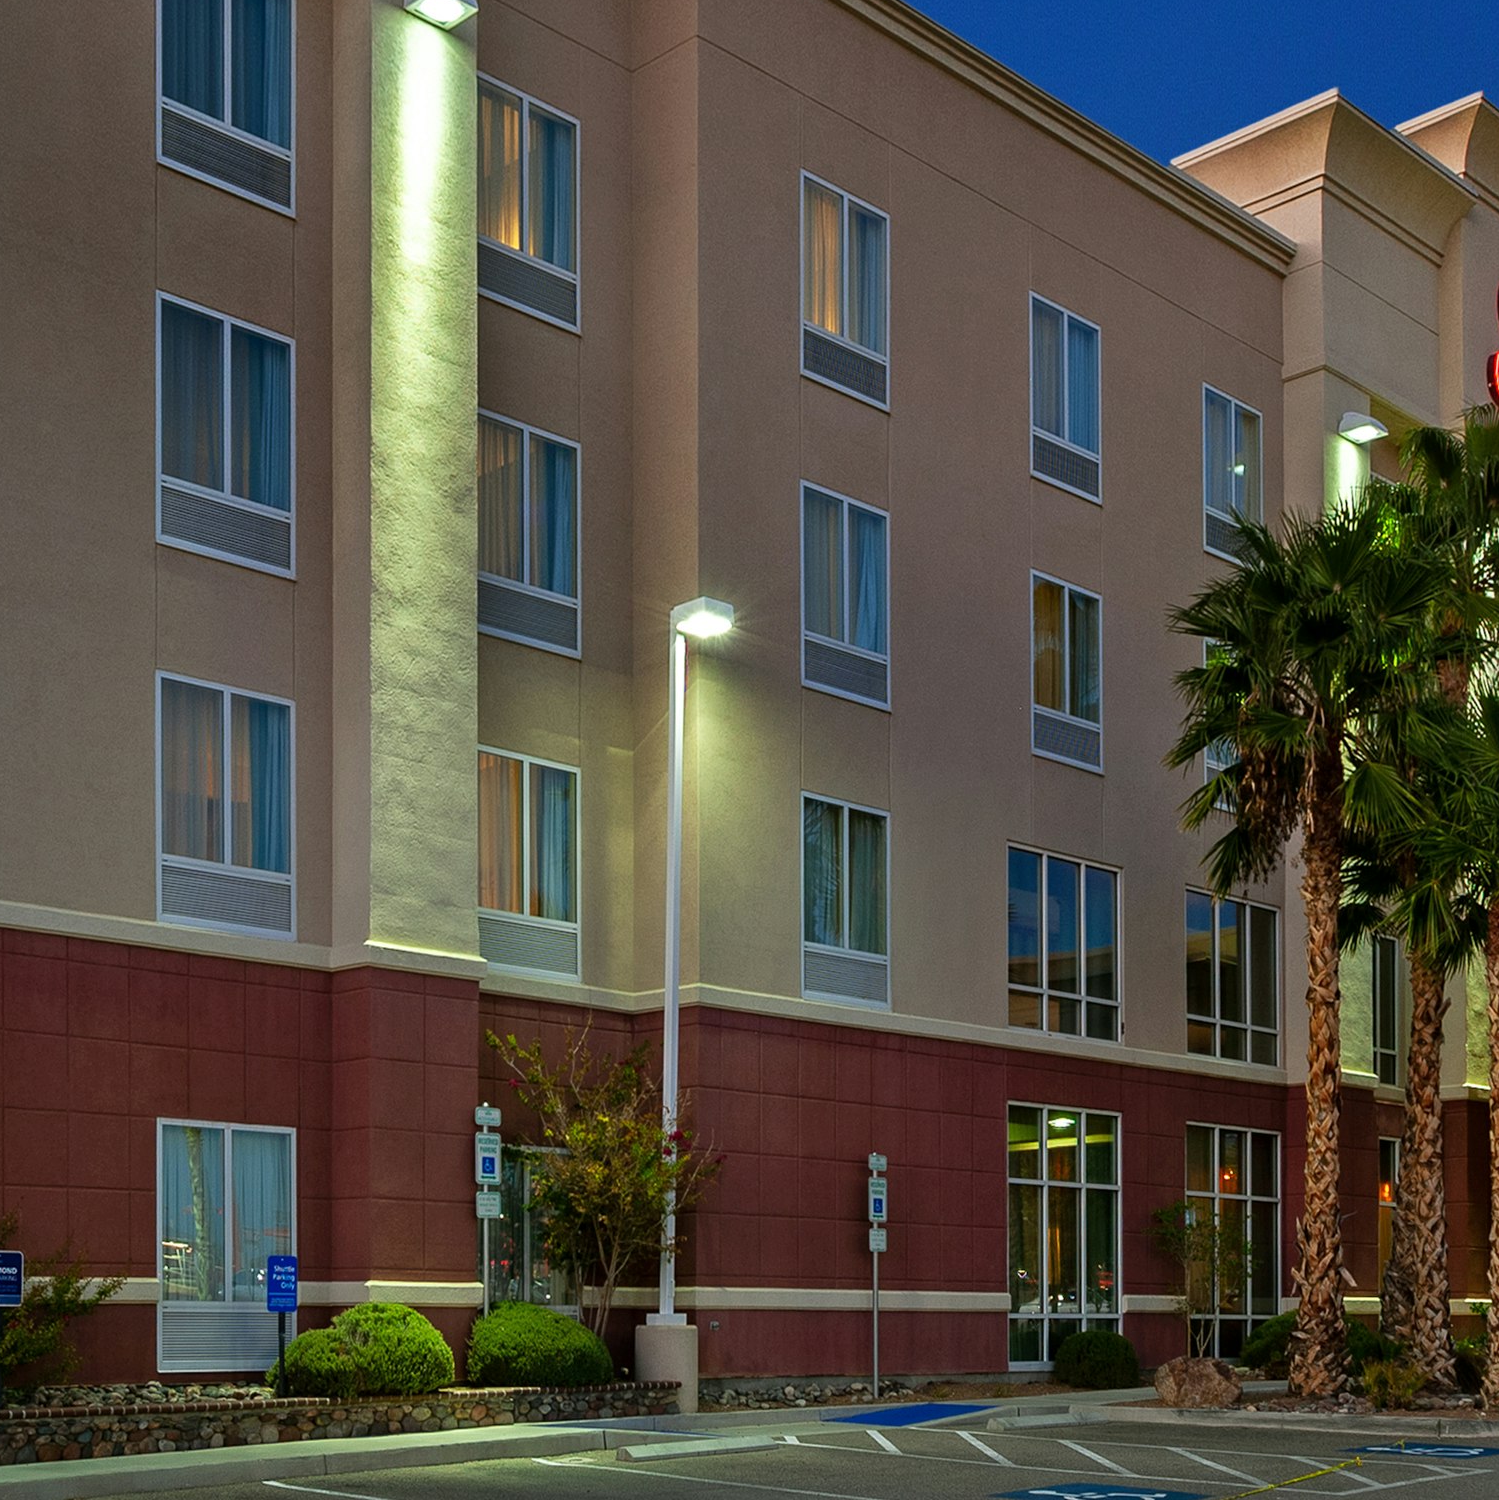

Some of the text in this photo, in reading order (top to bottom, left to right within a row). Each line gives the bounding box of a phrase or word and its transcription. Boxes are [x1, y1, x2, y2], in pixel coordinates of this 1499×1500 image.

[274, 1265, 295, 1273] Shuttle
[273, 1273, 295, 1282] Parking
[281, 1282, 295, 1291] Only
